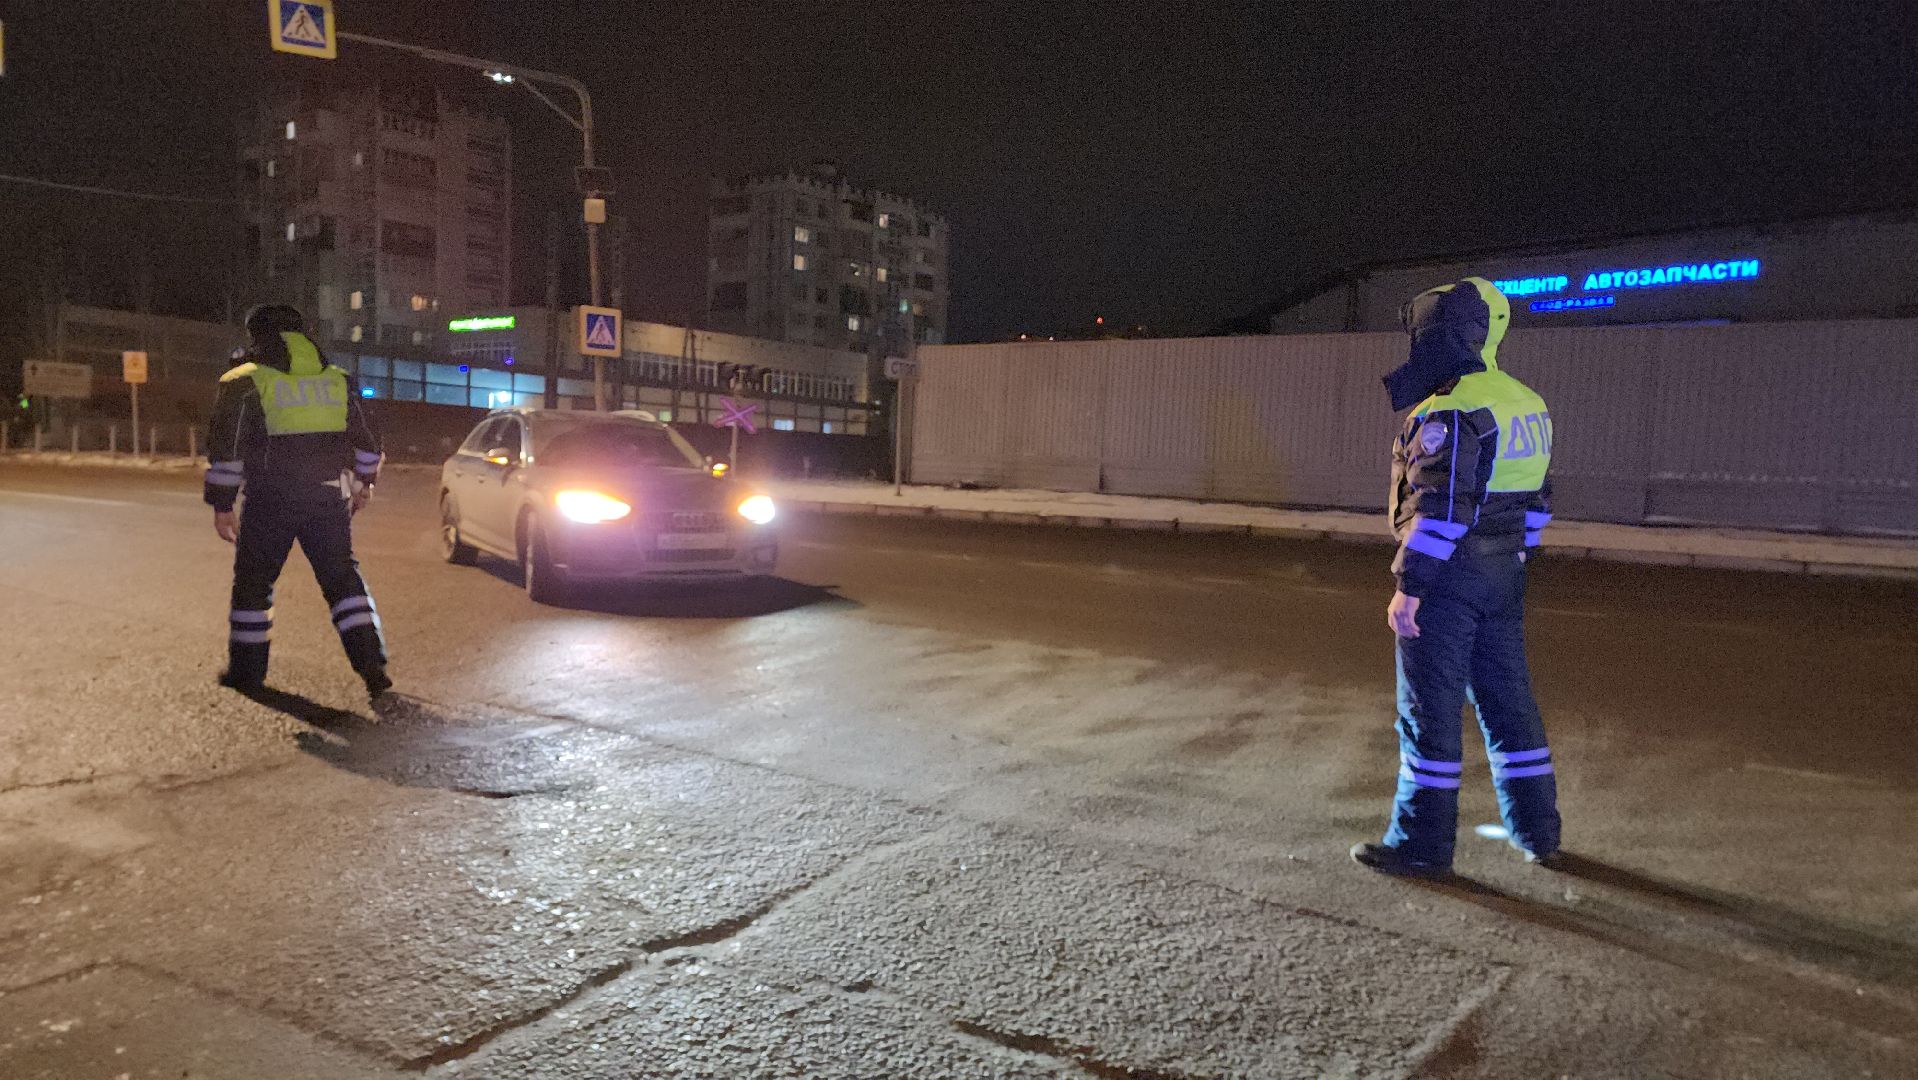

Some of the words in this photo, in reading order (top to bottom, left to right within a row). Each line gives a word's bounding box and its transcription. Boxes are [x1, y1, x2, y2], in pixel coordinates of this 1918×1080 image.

[1493, 276, 1568, 296] ЕХЦЕНТР
[1583, 259, 1759, 290] АВТОЗАПЧАСТИ
[274, 378, 342, 408] ДПС
